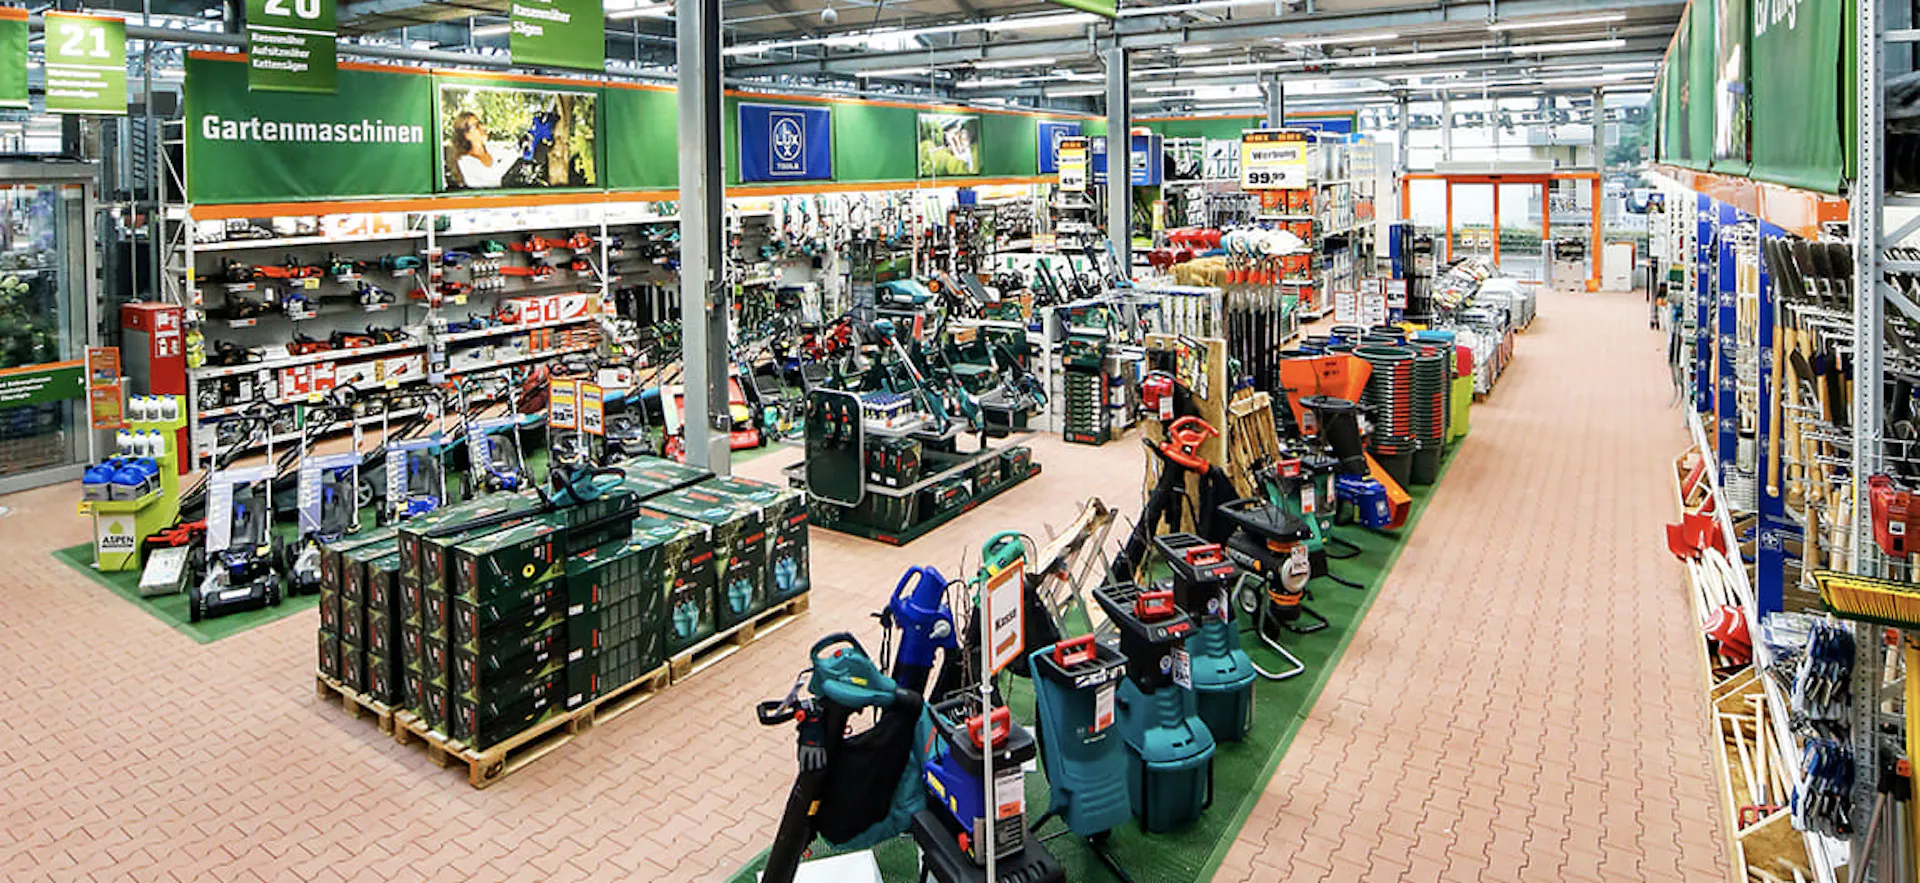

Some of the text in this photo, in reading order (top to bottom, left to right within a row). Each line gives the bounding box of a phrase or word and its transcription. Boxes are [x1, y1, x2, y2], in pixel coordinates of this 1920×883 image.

[513, 21, 543, 37] Sägen
[60, 23, 110, 57] 21
[202, 114, 424, 144] Gartenmaschinen
[1251, 149, 1297, 160] Werbung
[102, 535, 134, 544] ASPEN
[995, 608, 1017, 632] Kasse
